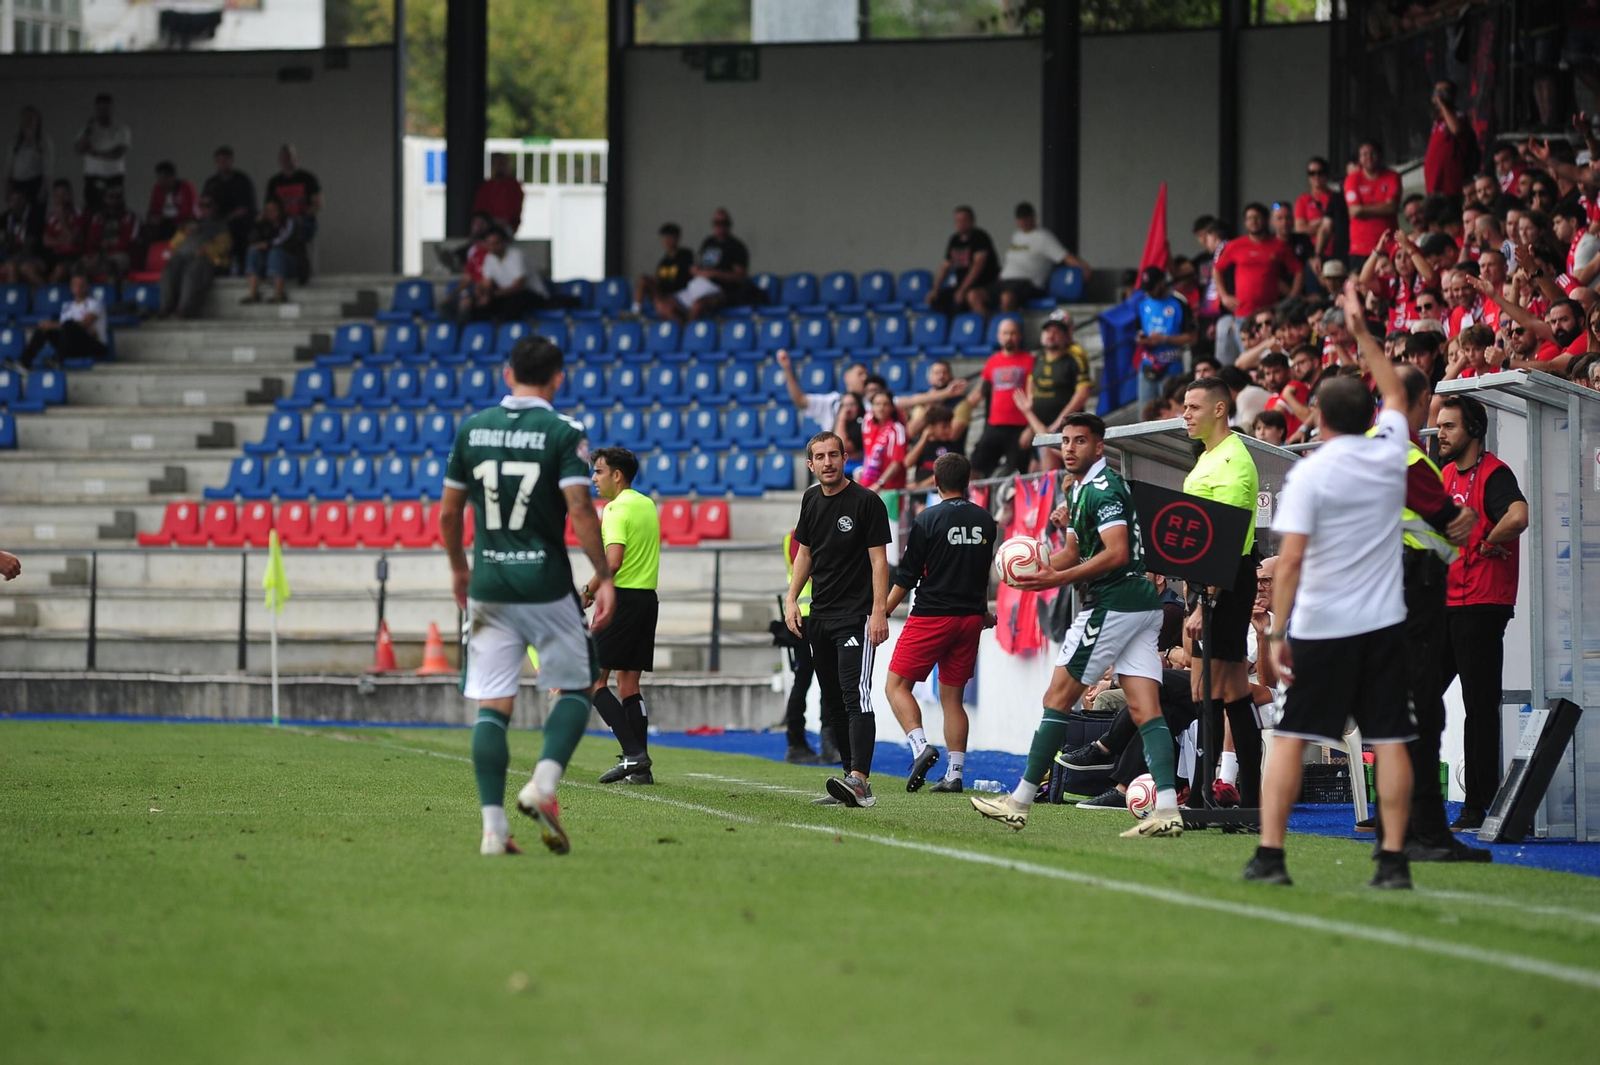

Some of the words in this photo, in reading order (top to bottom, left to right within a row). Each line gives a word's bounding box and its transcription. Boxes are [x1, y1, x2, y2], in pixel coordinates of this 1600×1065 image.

[469, 429, 504, 447] SERGI
[505, 429, 546, 450] LÓPEZ
[472, 460, 541, 531] 17
